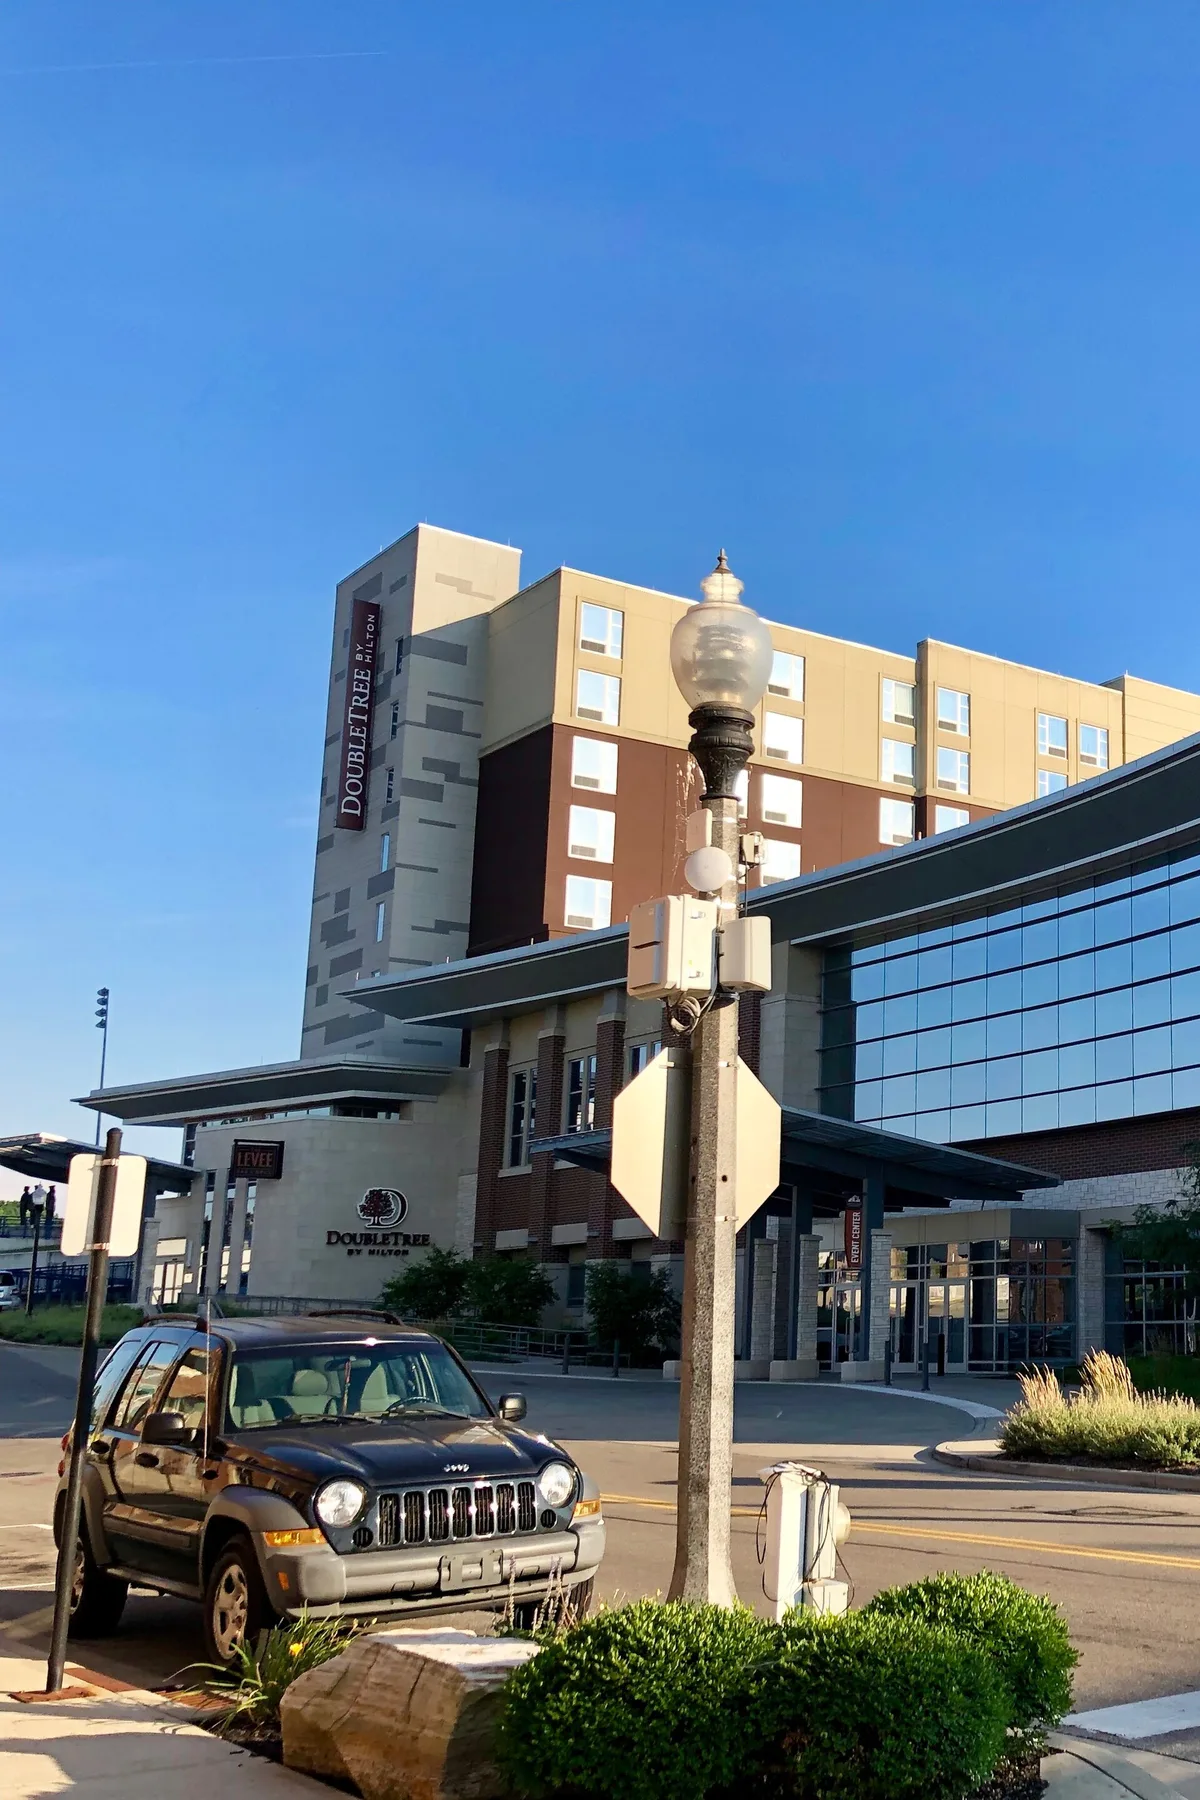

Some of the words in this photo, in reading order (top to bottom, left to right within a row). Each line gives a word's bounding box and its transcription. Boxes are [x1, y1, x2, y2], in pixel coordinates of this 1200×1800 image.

[365, 614, 375, 663] HILTON
[355, 643, 365, 661] BY
[341, 668, 371, 817] DOUBLETREE
[237, 1151, 273, 1168] LEVEE
[852, 1211, 861, 1239] CENTER
[368, 1249, 409, 1257] HILTON
[851, 1240, 860, 1263] EVENT
[443, 1463, 470, 1472] Jeep
